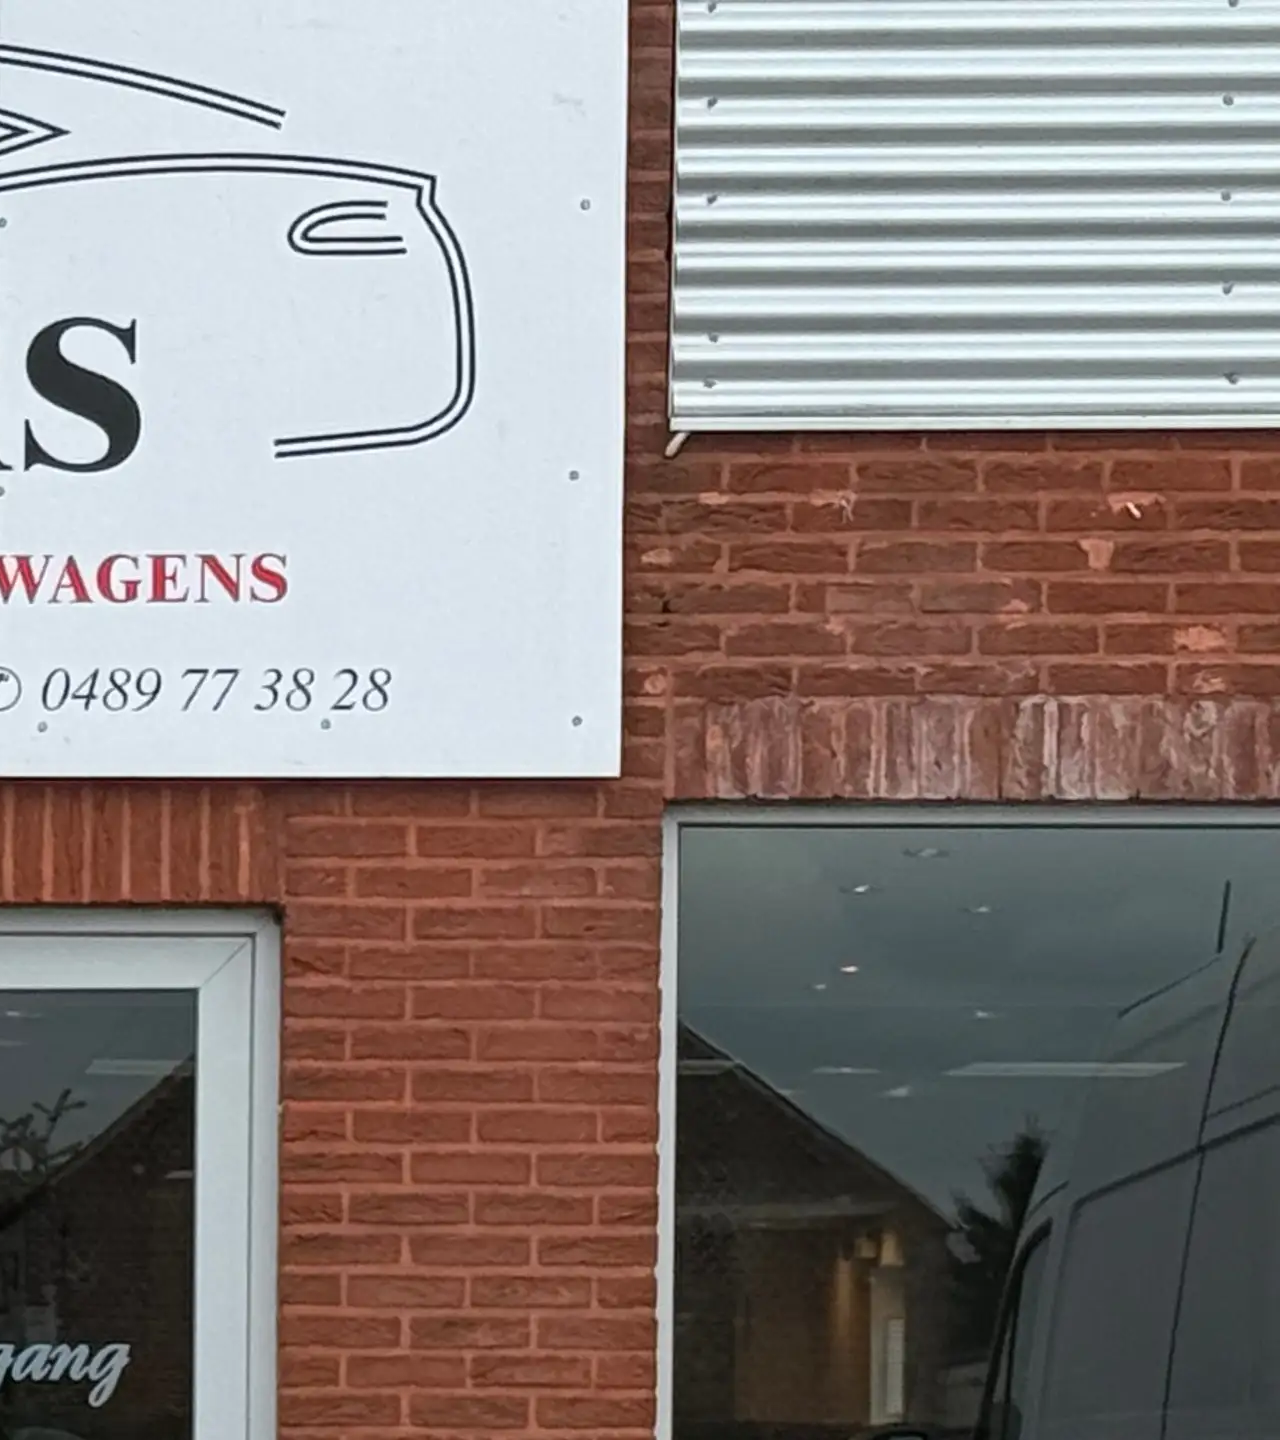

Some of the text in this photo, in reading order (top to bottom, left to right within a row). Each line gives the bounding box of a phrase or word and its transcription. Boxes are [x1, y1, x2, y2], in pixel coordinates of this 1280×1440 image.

[41, 668, 392, 711] 0489 77 38 28
